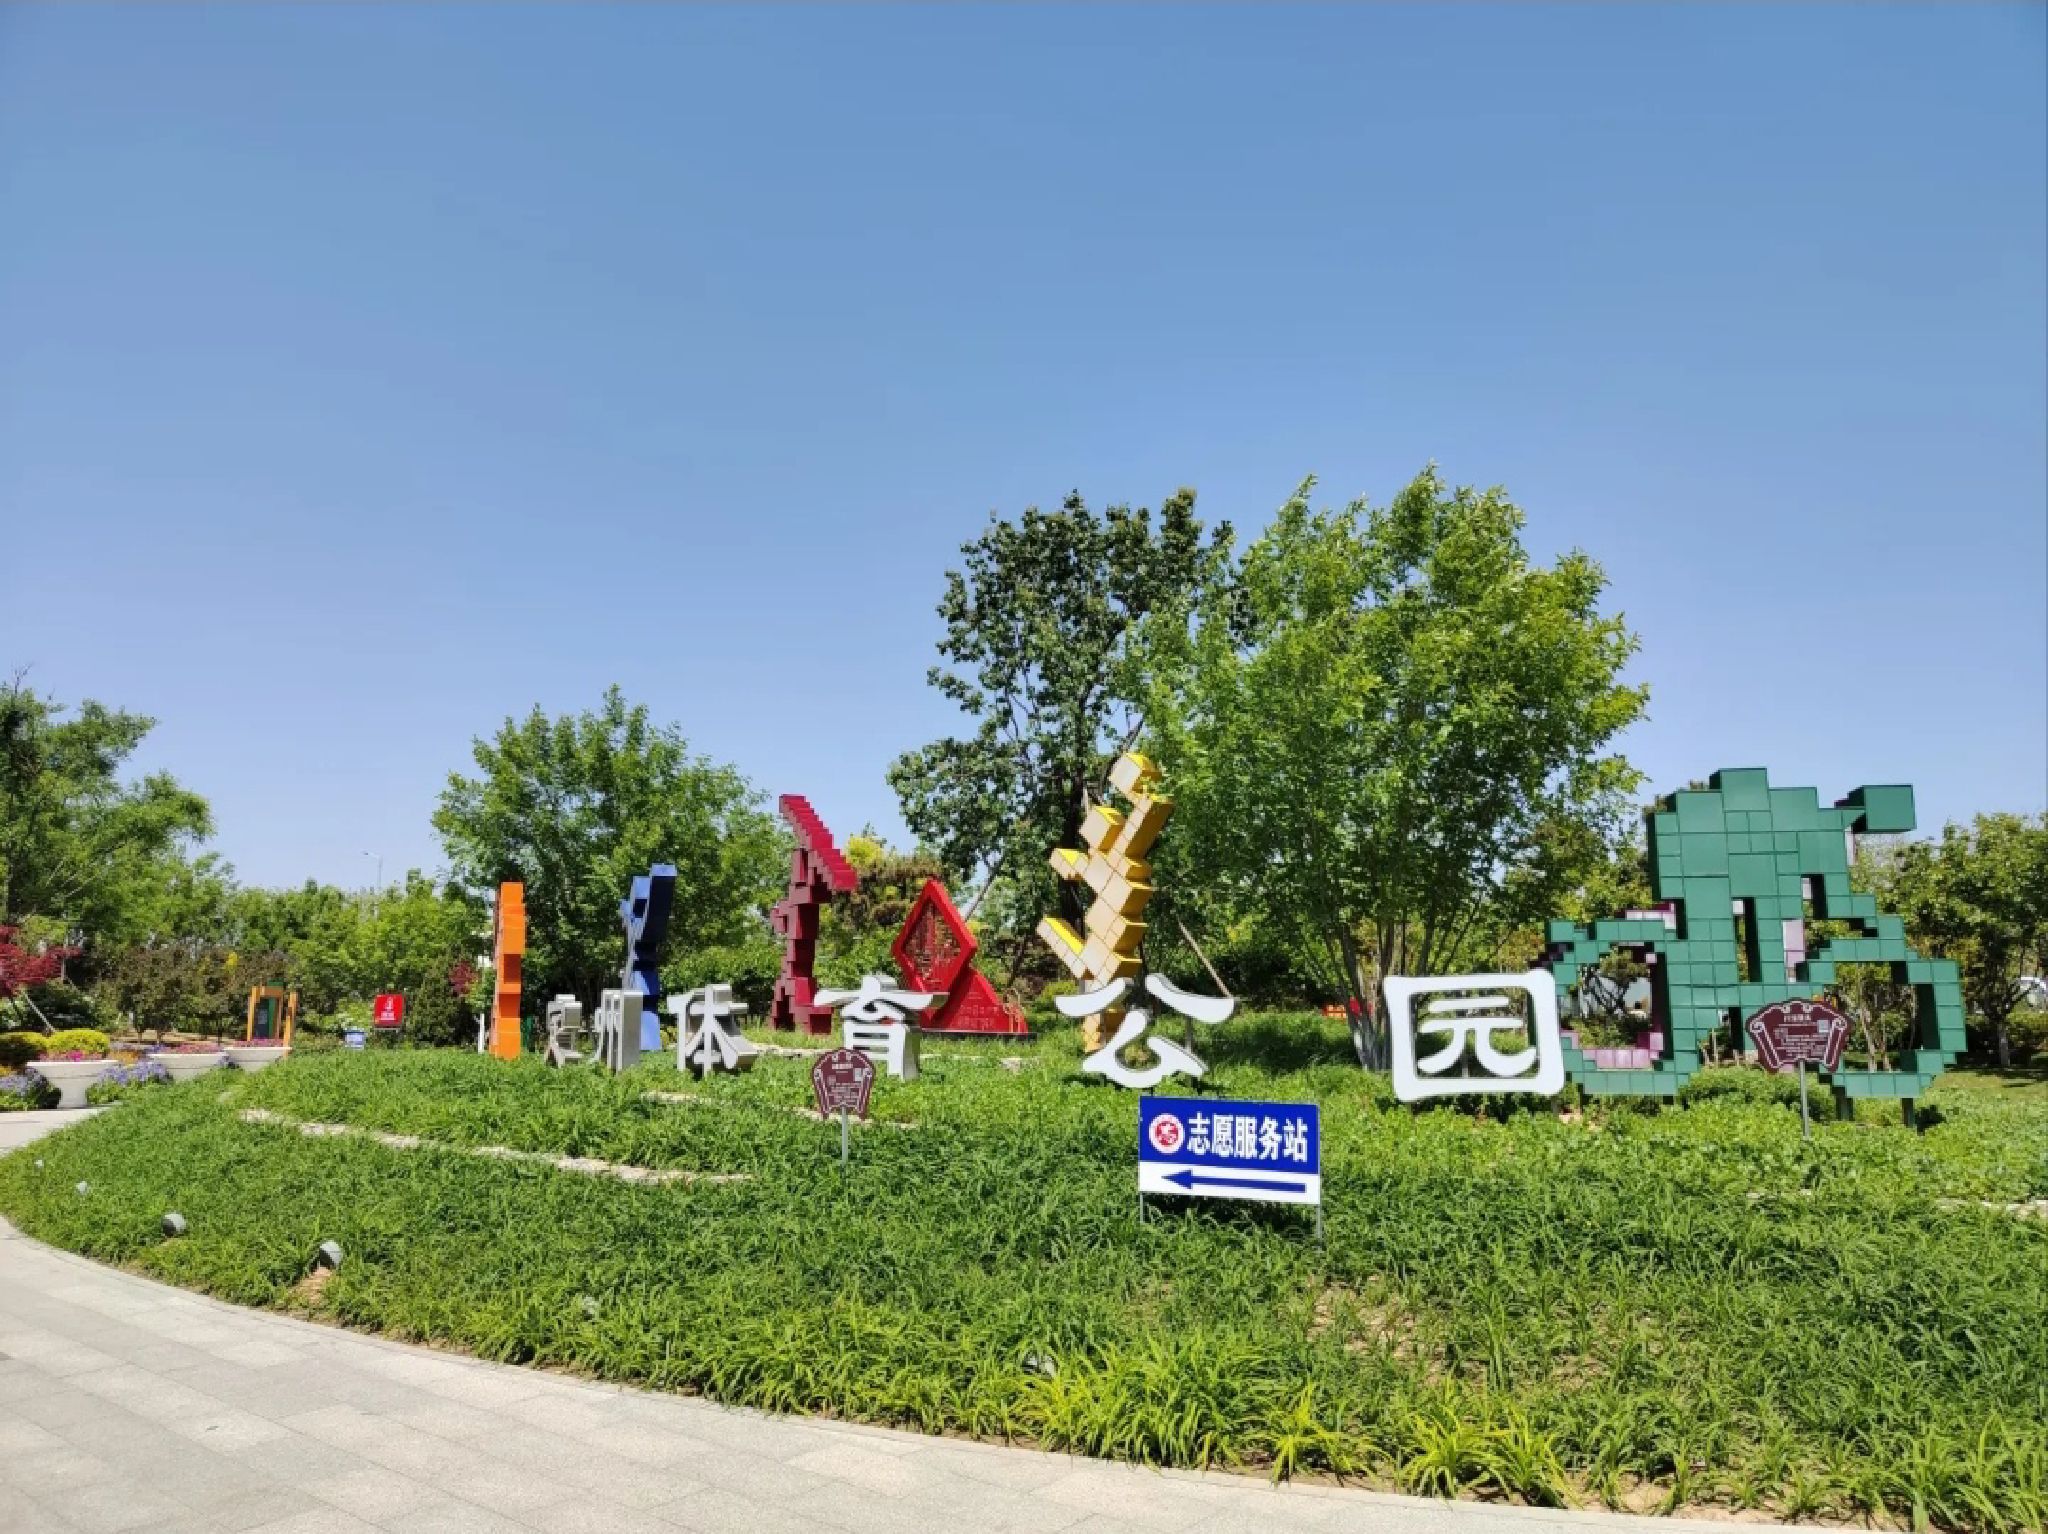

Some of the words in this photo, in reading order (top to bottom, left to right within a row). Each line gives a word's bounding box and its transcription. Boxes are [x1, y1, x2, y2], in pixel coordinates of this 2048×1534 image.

[1187, 1112, 1309, 1163] 志愿服务站
